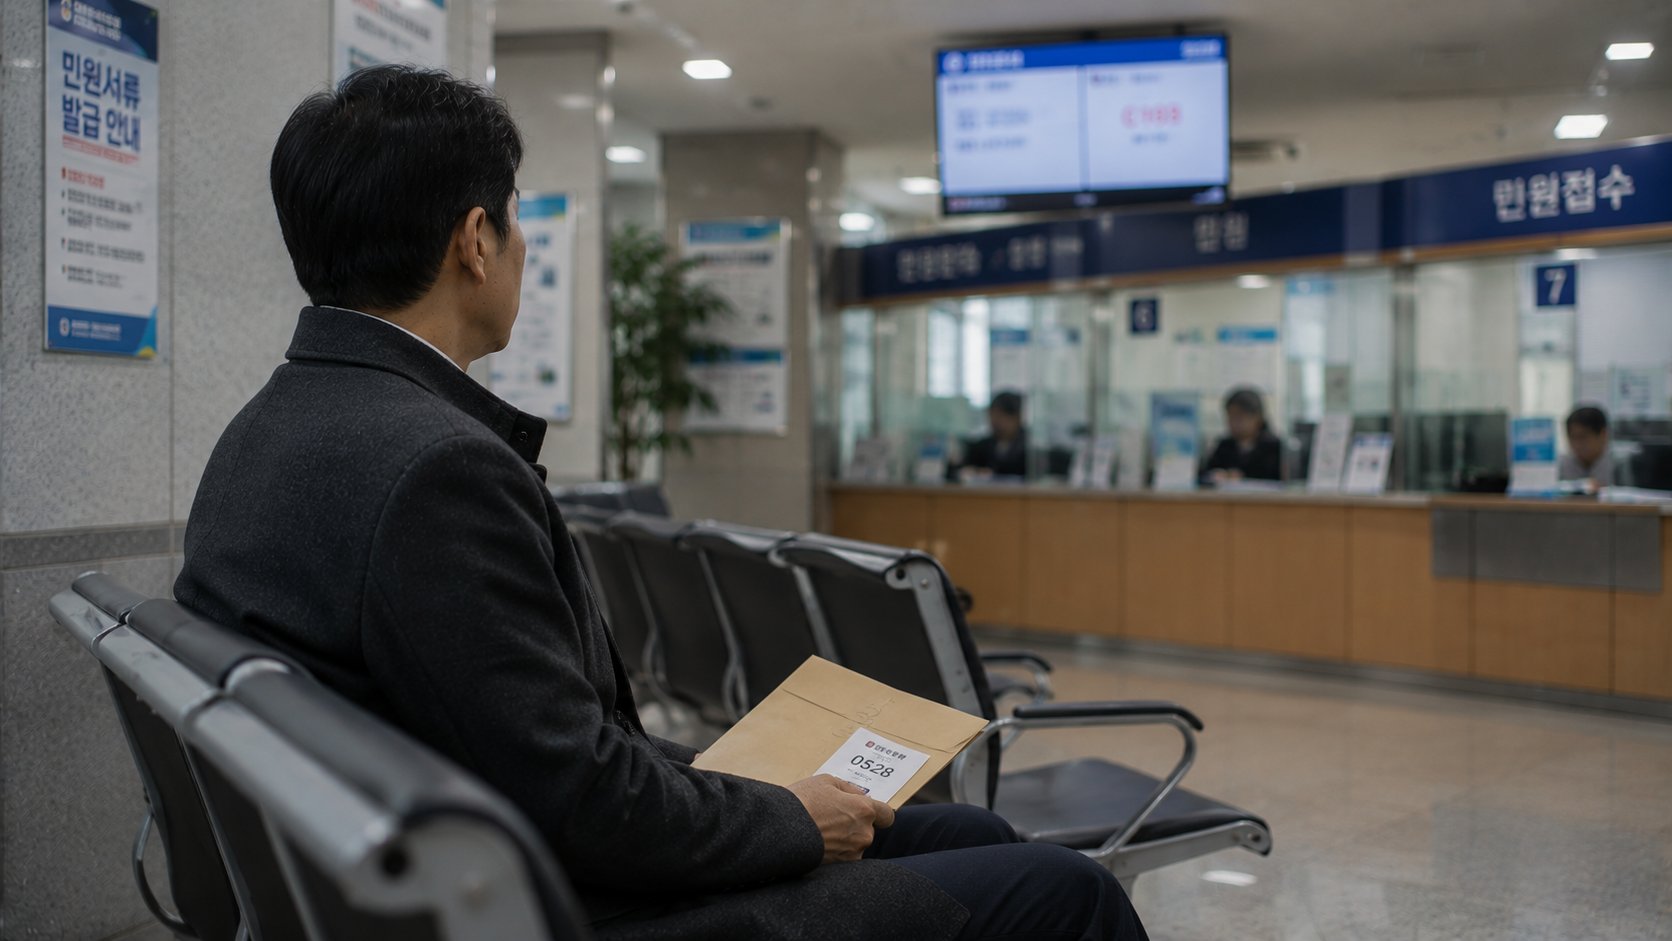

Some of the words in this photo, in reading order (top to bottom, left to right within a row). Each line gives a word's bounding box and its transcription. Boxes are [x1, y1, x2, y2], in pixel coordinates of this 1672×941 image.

[62, 50, 140, 110] 민원서류
[62, 94, 100, 140] 발급
[106, 108, 140, 153] 안내
[1493, 164, 1635, 223] 민원접수
[1545, 268, 1567, 305] 7
[850, 755, 894, 778] 0528
